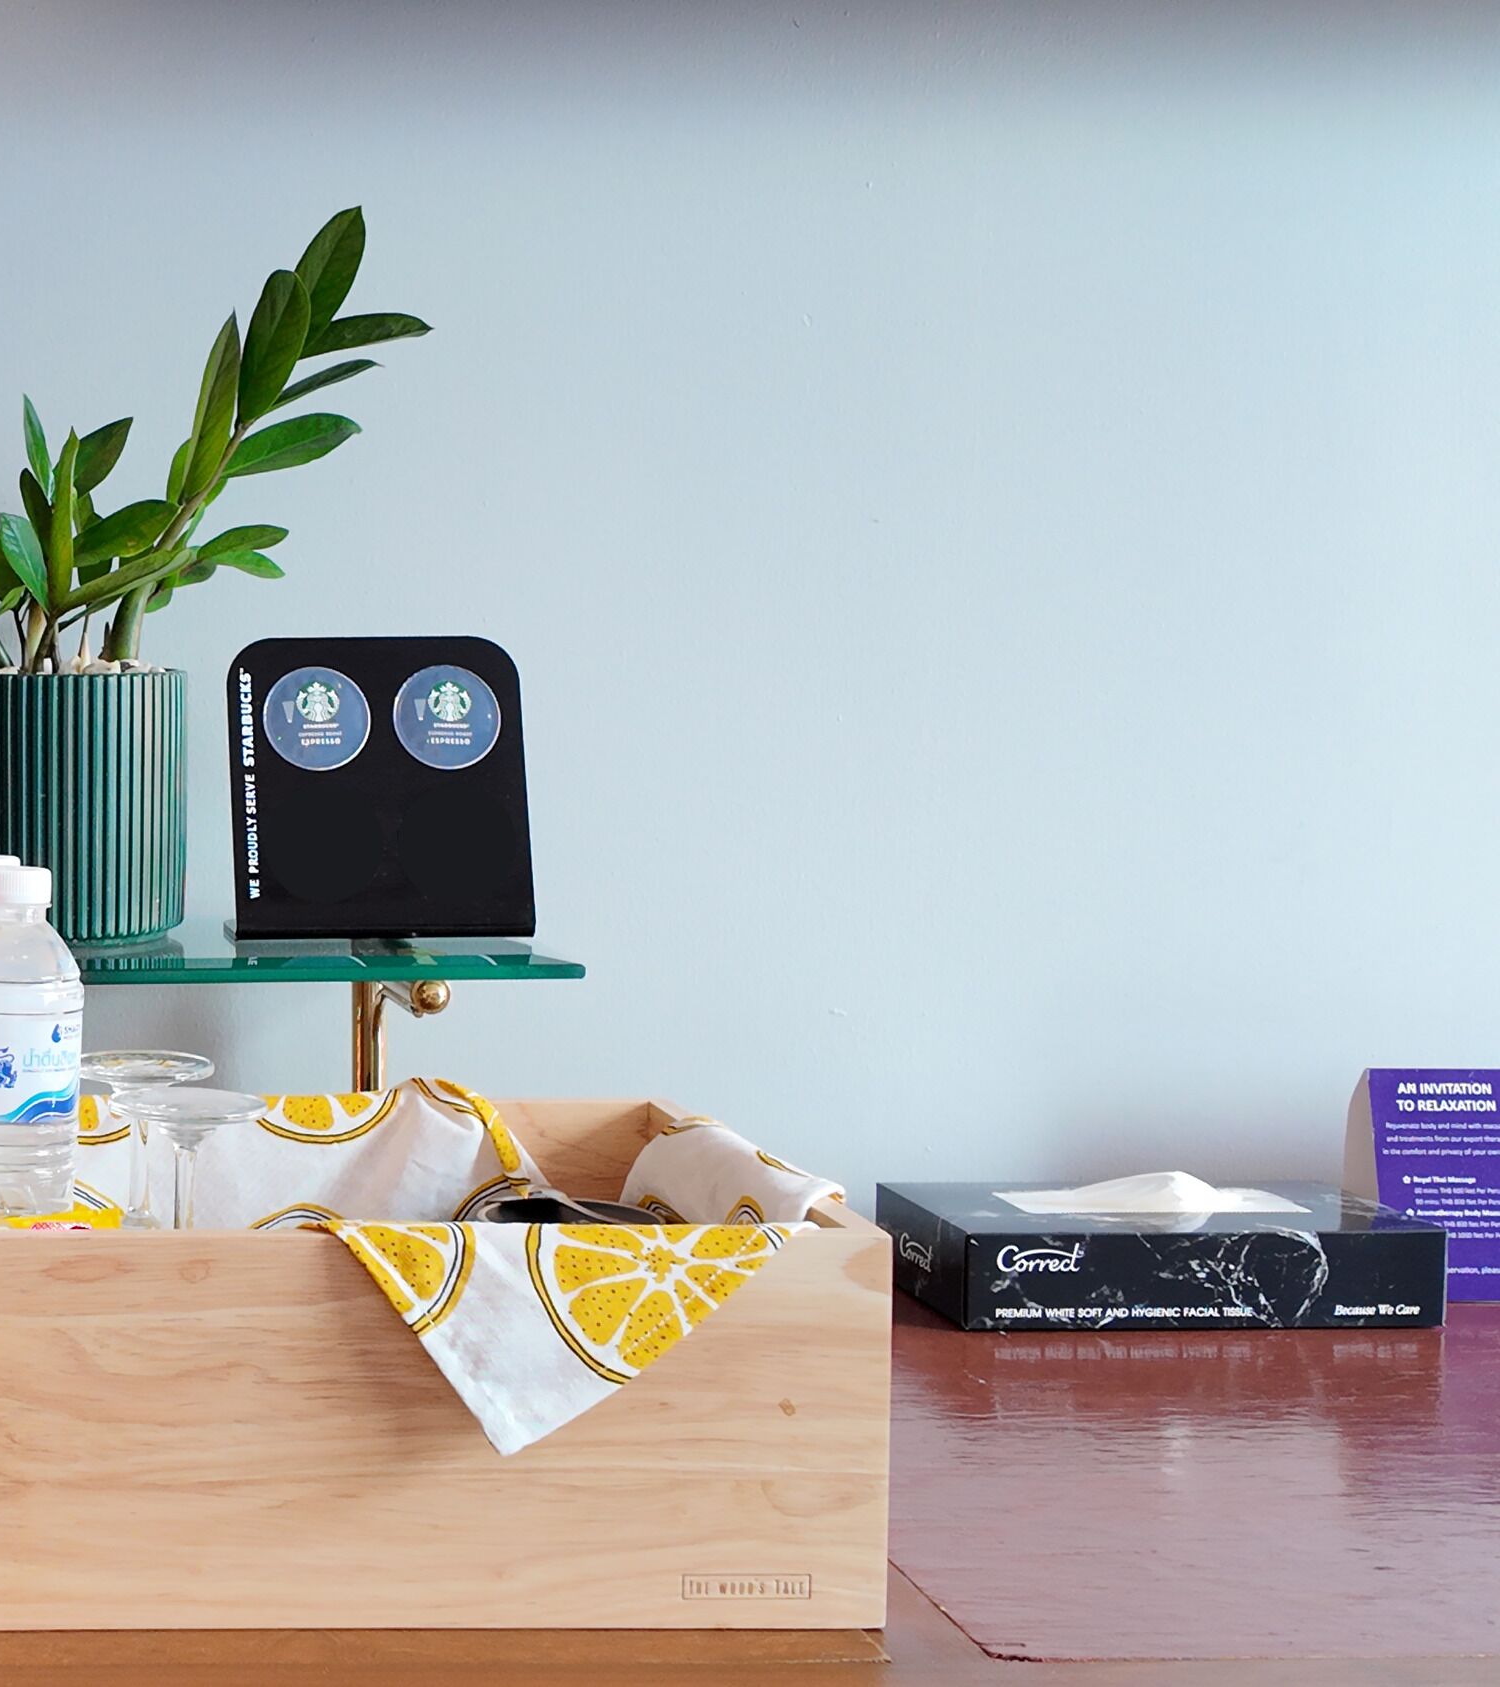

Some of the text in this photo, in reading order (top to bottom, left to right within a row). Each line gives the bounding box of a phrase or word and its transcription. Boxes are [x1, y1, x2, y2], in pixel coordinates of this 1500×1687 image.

[430, 737, 471, 745] ESPRESSO
[245, 774, 256, 814] SERVE
[247, 816, 260, 874] PROUDLY
[249, 878, 261, 900] WE
[1397, 1082, 1492, 1095] AN INVITATION
[1396, 1099, 1497, 1112] TO RELAXATION
[1420, 1122, 1437, 1131] body
[1438, 1122, 1450, 1130] and
[1412, 1175, 1476, 1184] Royal Thai Massage
[1416, 1209, 1463, 1217] Aromatherapy
[1464, 1209, 1481, 1217] Body
[900, 1232, 932, 1272] Correct
[996, 1242, 1081, 1272] Correct
[995, 1306, 1253, 1318] PREMIUM WHITE SOFT AND HYGIENIC FACIAL TISSUE
[1333, 1303, 1421, 1316] Because We Care
